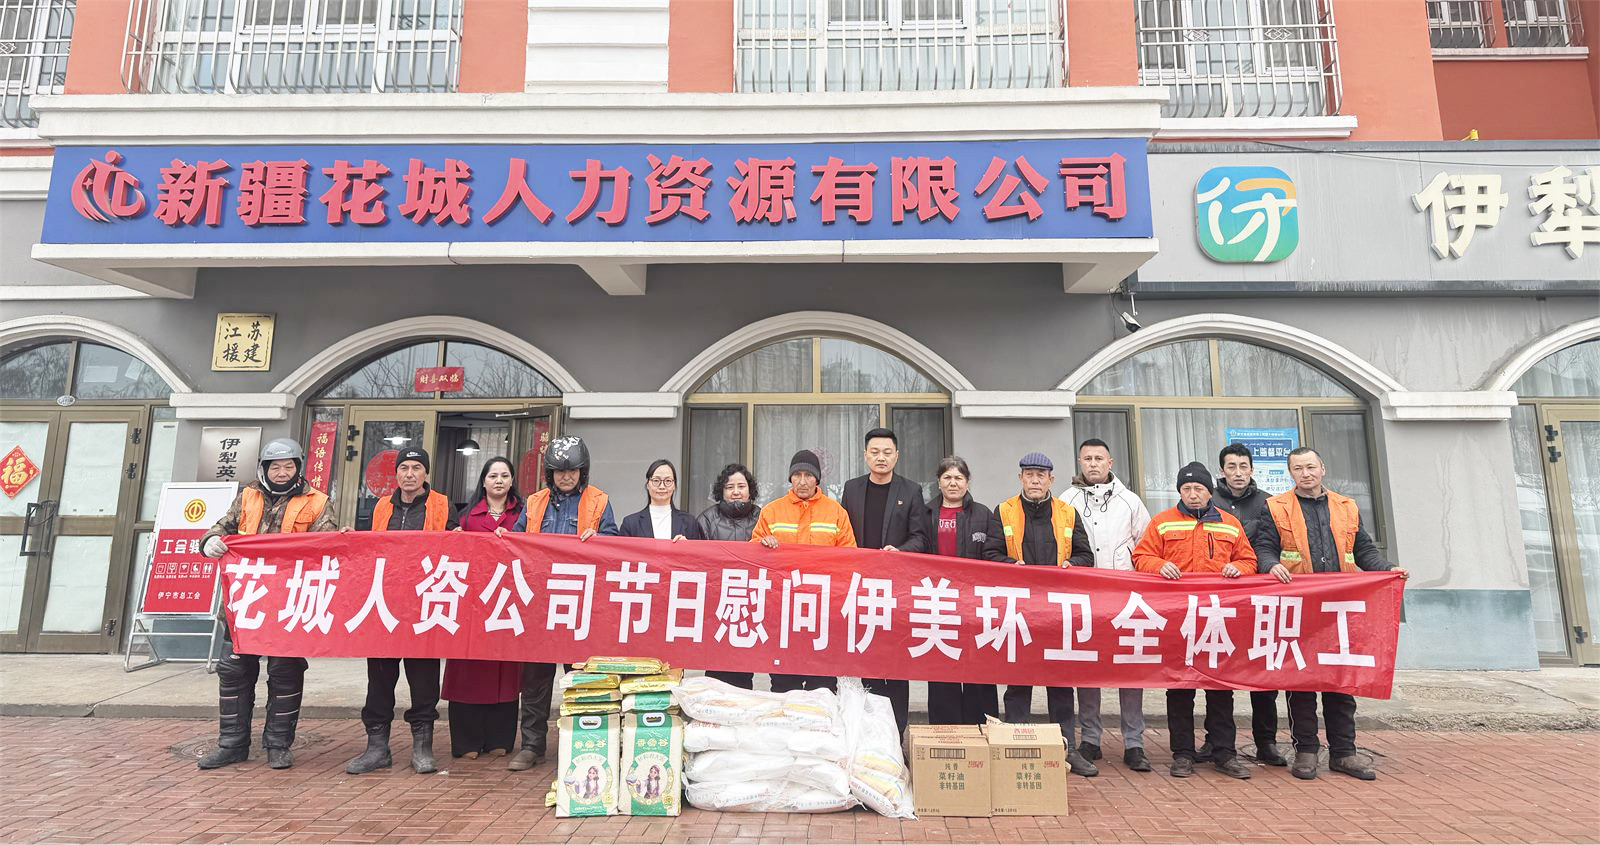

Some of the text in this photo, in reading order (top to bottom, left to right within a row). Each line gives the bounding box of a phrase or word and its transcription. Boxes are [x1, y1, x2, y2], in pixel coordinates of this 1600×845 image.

[155, 152, 1127, 228] 新疆花城人力资源有限公司
[1412, 165, 1600, 260] 伊犁
[224, 320, 262, 341] 江苏
[222, 342, 262, 363] 援建
[1, 456, 28, 485] 福
[216, 438, 241, 481] 伊犁英
[157, 591, 201, 600] 伊宁市总工会
[226, 555, 1376, 671] 花城人资公司节日慰问伊美环卫全体职工
